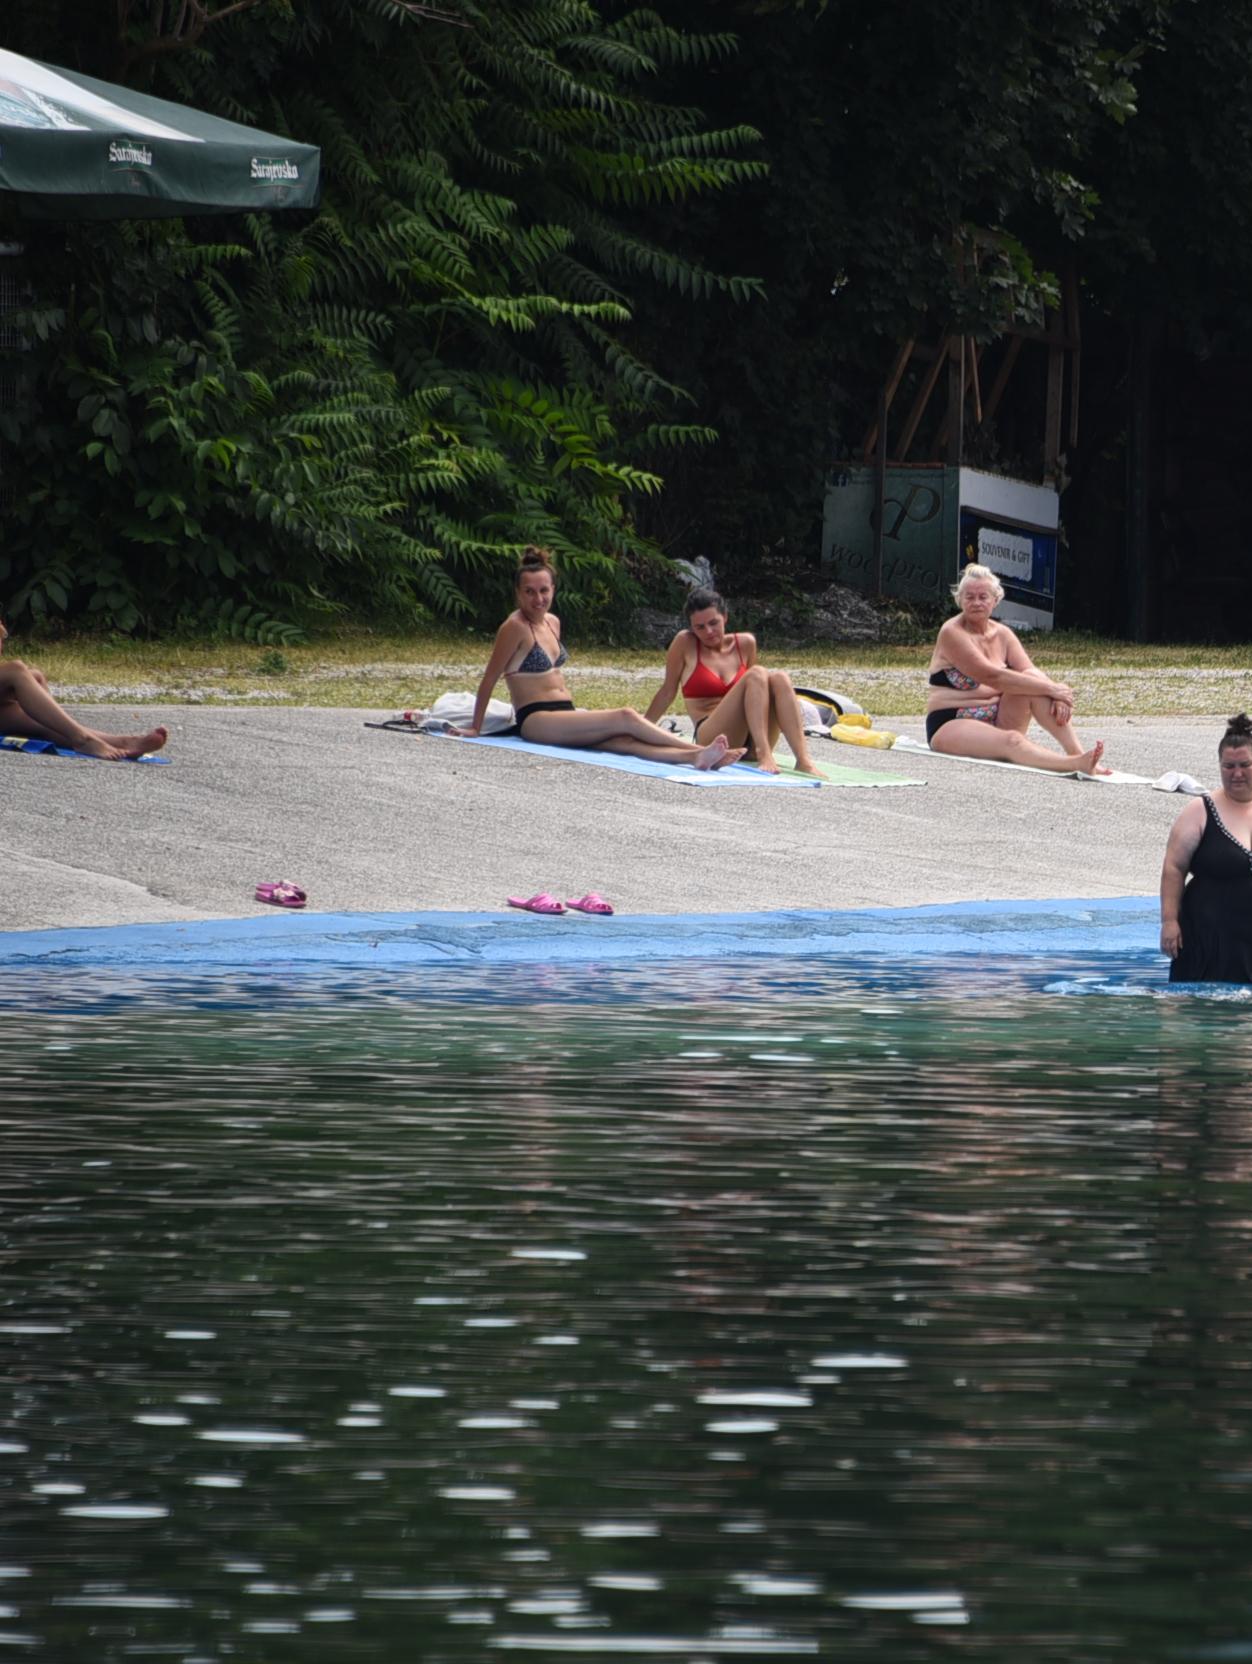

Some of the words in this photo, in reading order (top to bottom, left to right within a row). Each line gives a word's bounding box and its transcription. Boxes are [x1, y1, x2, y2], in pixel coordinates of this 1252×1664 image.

[981, 542, 1011, 560] SOUVENIR
[1011, 549, 1017, 562] &
[1017, 551, 1030, 564] GIFT
